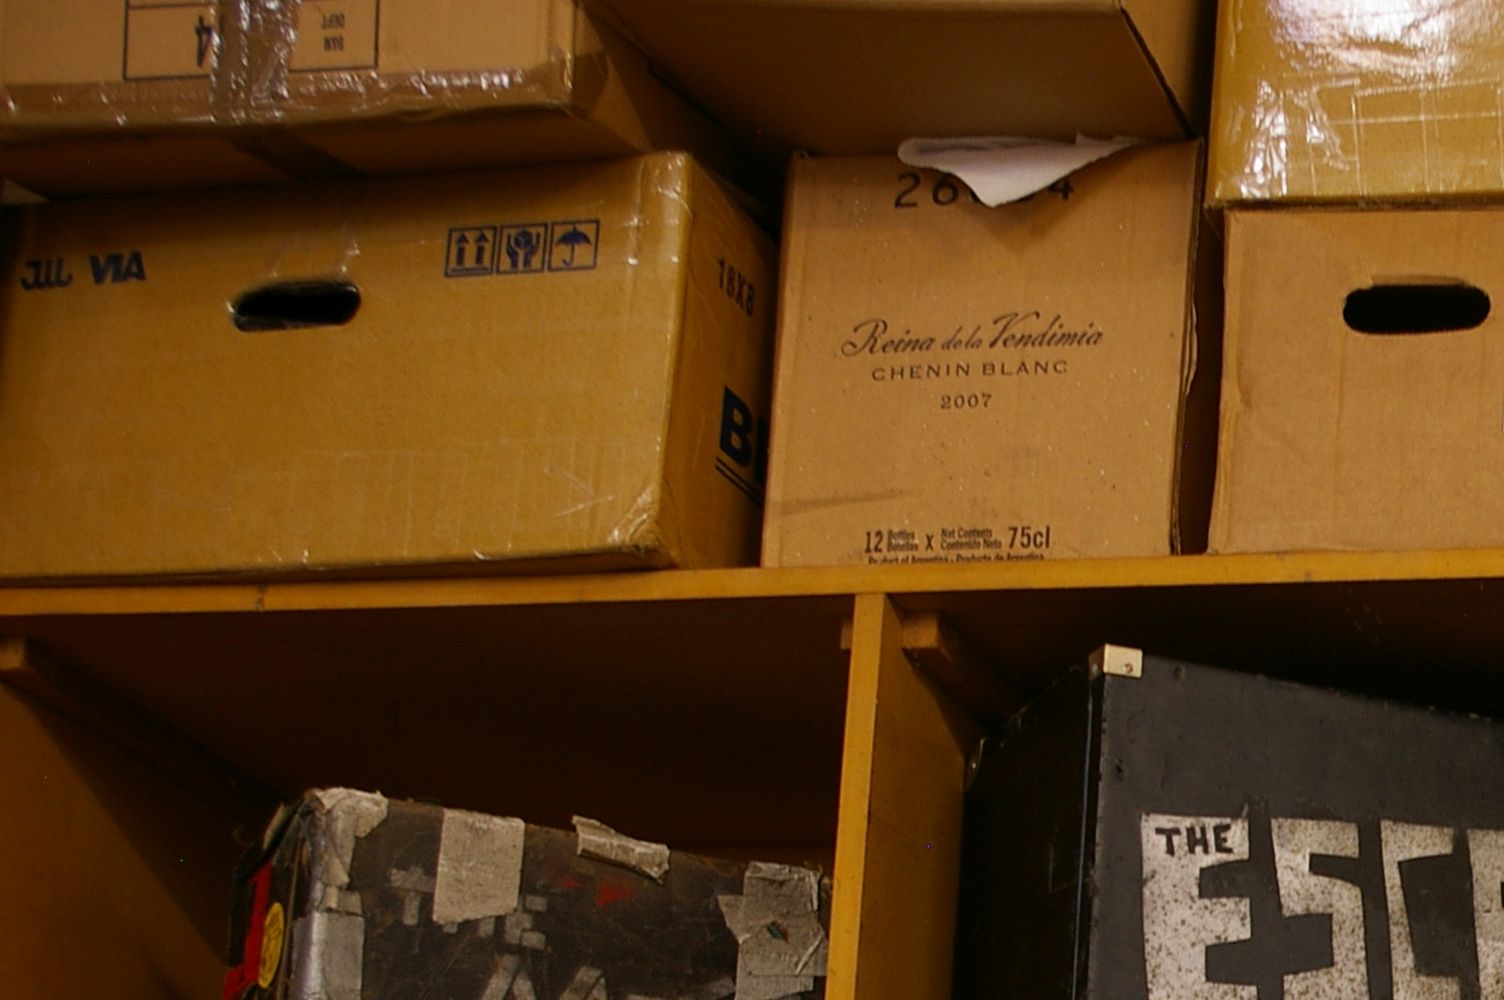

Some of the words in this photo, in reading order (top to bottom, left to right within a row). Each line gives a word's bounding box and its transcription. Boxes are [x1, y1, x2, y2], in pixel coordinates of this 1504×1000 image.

[840, 317, 936, 358] Reina
[988, 310, 1104, 350] Vendimia
[871, 362, 971, 382] CHENIN
[981, 359, 1068, 377] BLANC
[940, 393, 993, 410] 2007
[864, 530, 883, 554] 12
[1007, 525, 1051, 550] 75cl
[1155, 824, 1235, 857] THE
